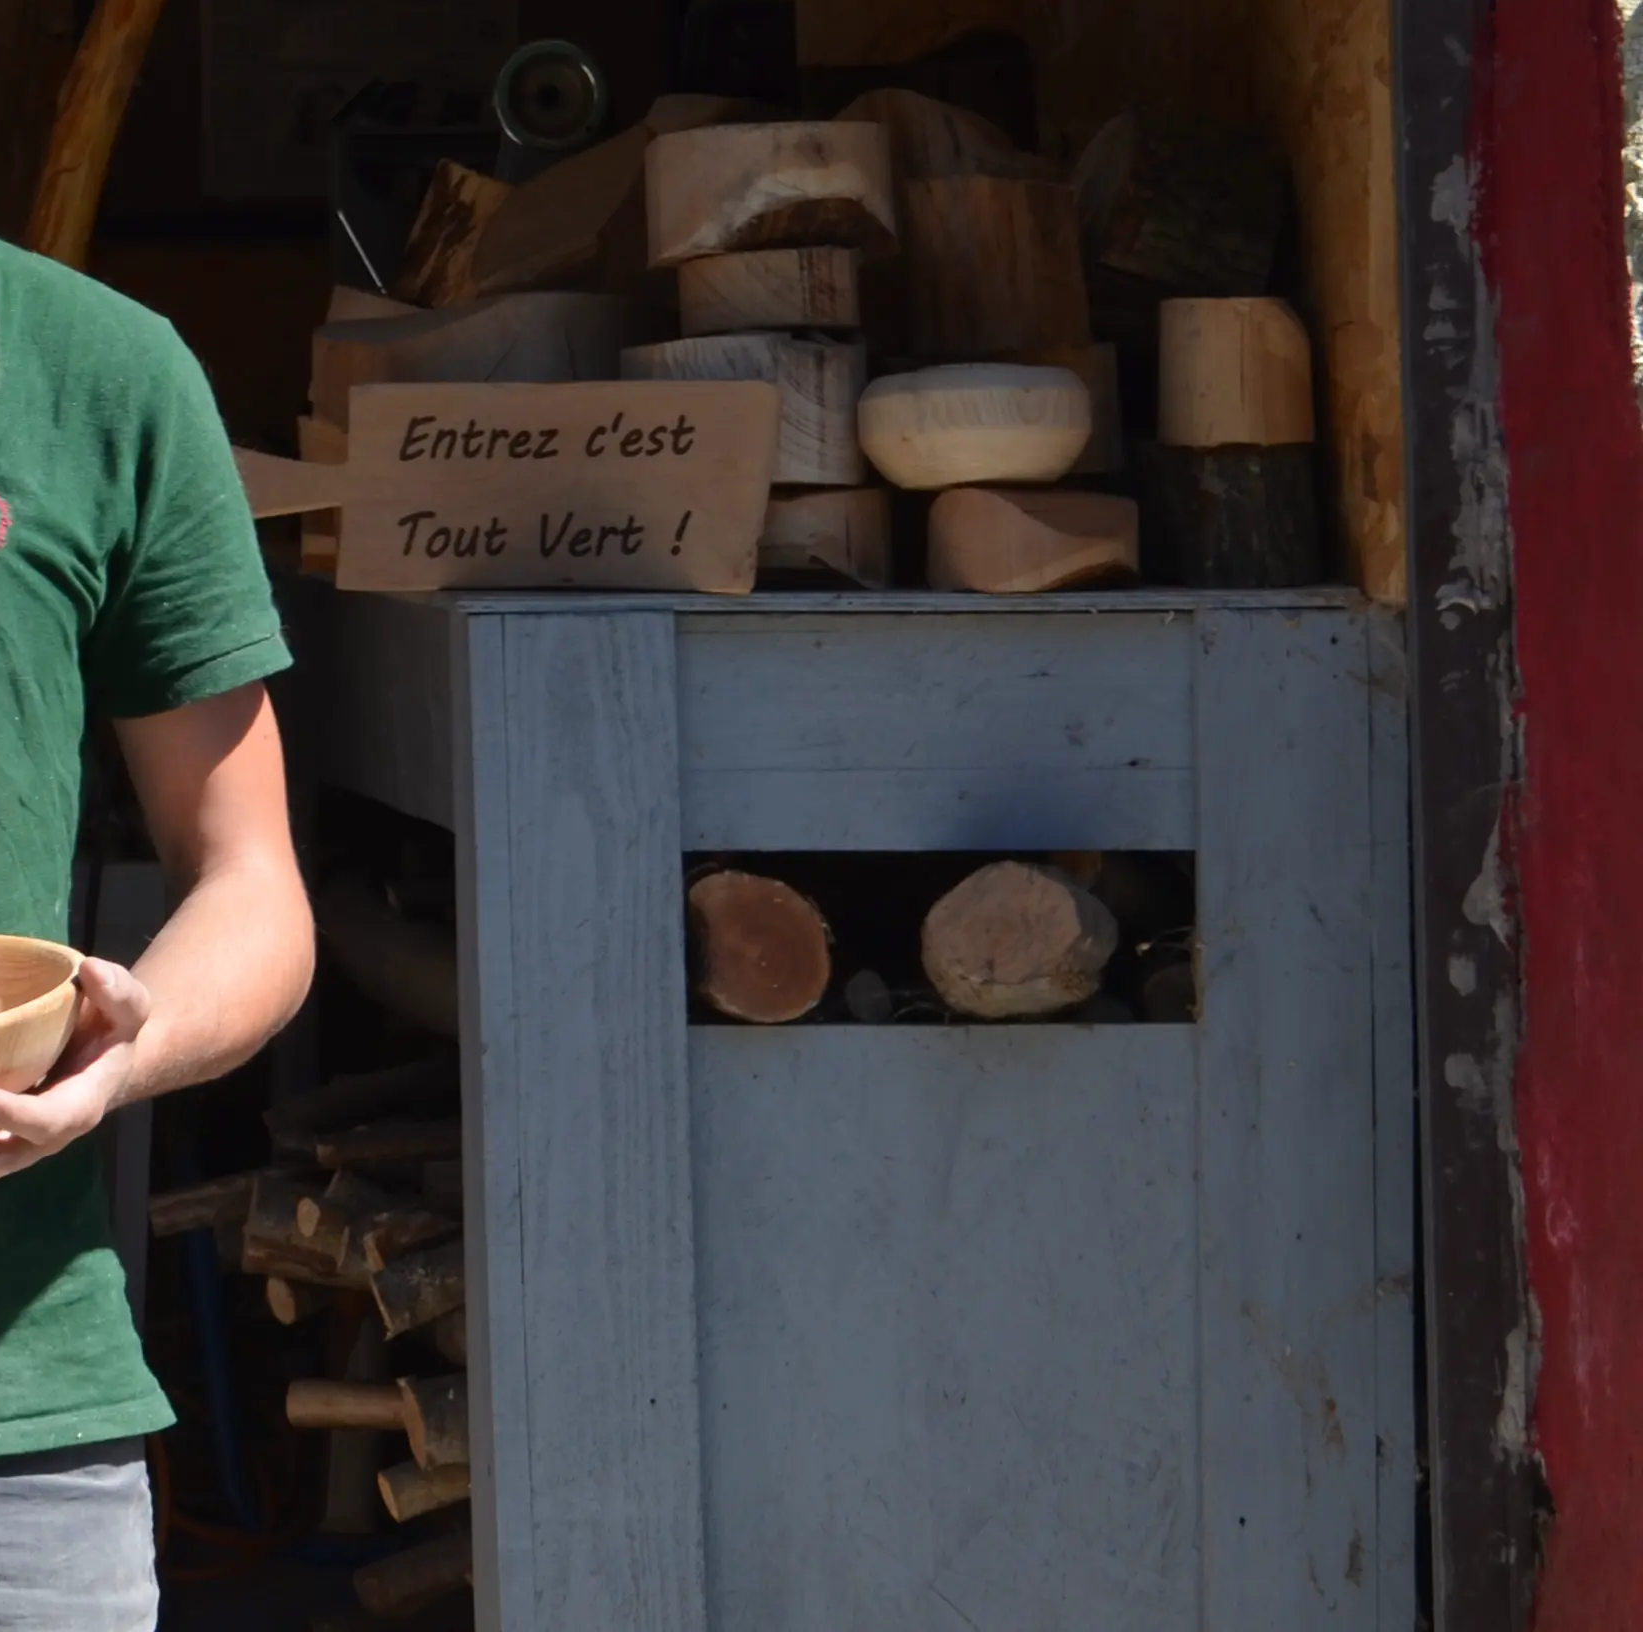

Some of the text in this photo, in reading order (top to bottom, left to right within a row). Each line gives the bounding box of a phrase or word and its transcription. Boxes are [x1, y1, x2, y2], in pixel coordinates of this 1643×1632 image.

[398, 411, 697, 463] Entrez c'est
[396, 510, 693, 559] Tout Vert !
